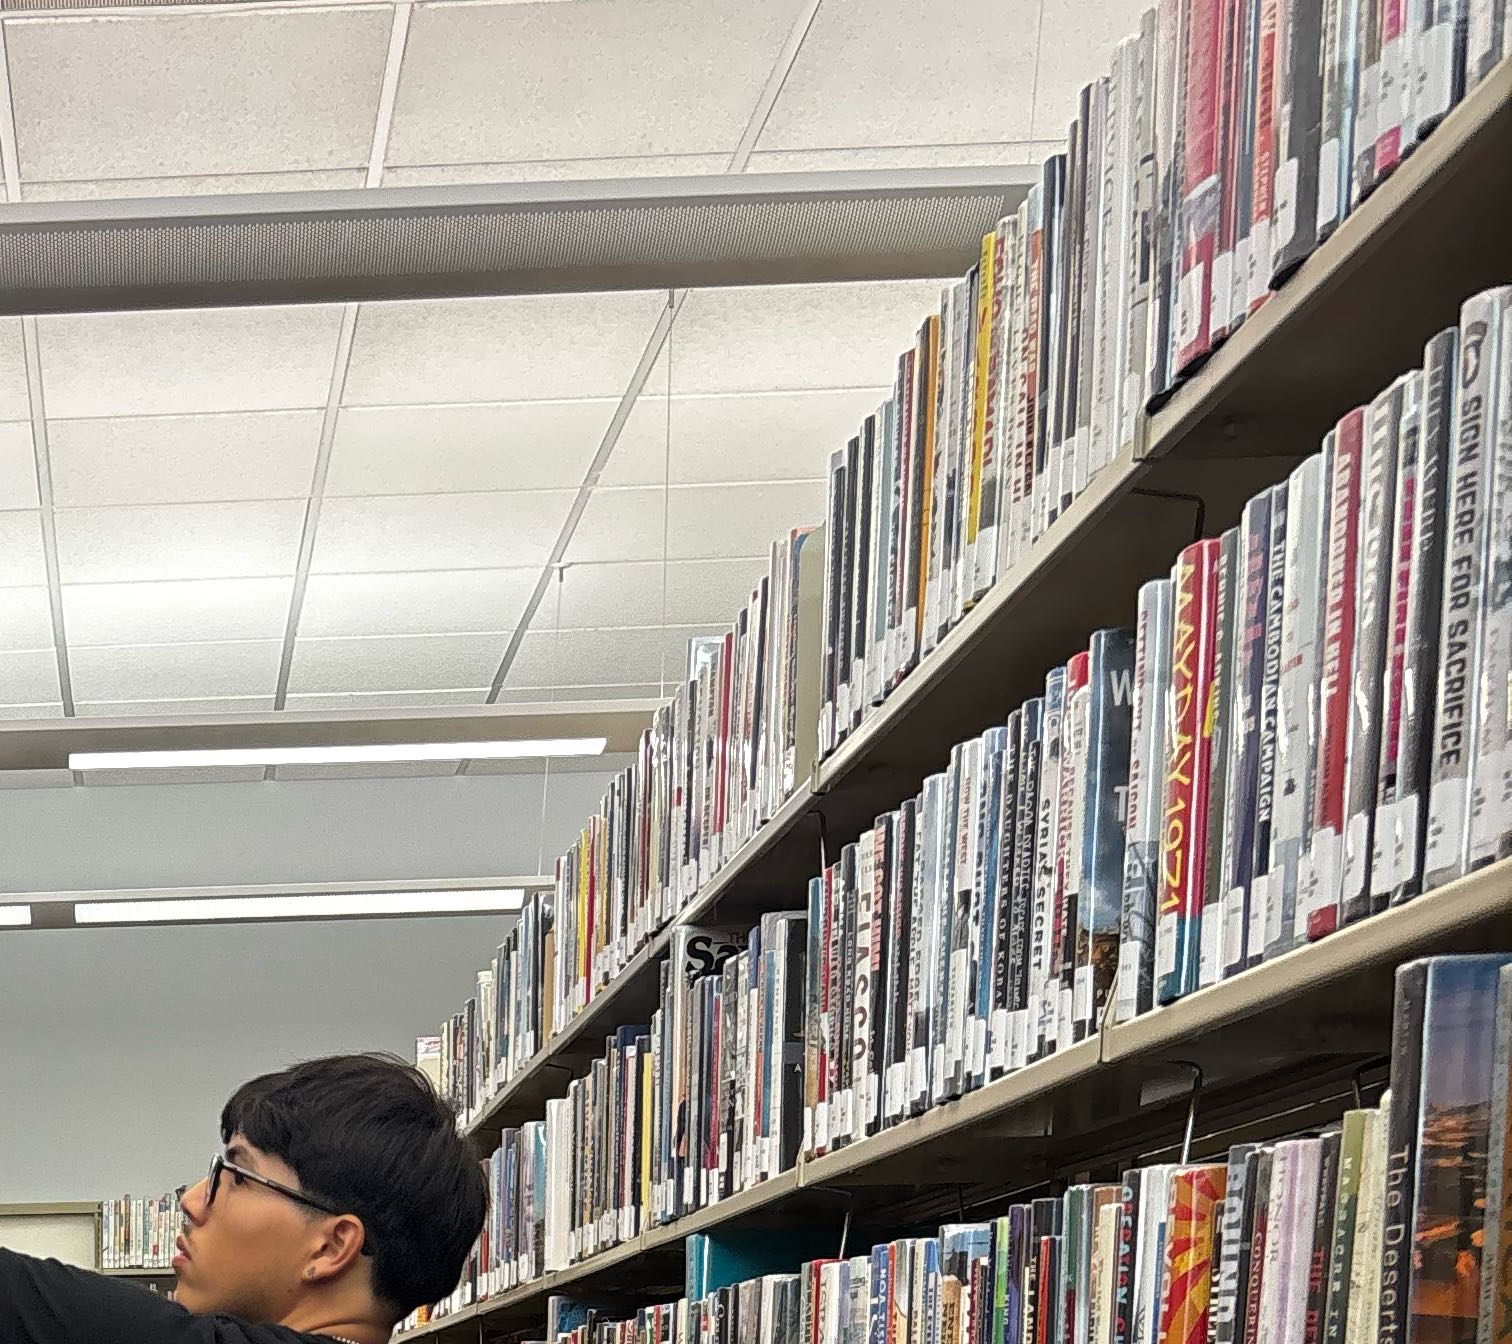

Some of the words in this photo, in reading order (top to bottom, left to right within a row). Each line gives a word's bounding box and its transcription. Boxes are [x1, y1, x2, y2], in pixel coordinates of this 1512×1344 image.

[1459, 395, 1483, 465] SIGN
[1453, 471, 1478, 548] HERE
[1450, 558, 1472, 613] FOR
[1171, 562, 1197, 786] MAYDAY
[1262, 586, 1285, 711] CAMBODIAN
[1439, 618, 1468, 766] SACRIFICE
[1257, 717, 1277, 823] CAMPAIGN
[1159, 797, 1184, 914] 1971
[1032, 886, 1044, 971] SECRET
[1385, 1145, 1410, 1208] The
[1332, 1157, 1353, 1289] MASSACRE
[1308, 1248, 1325, 1295] THE
[1328, 1310, 1339, 1339] IN
